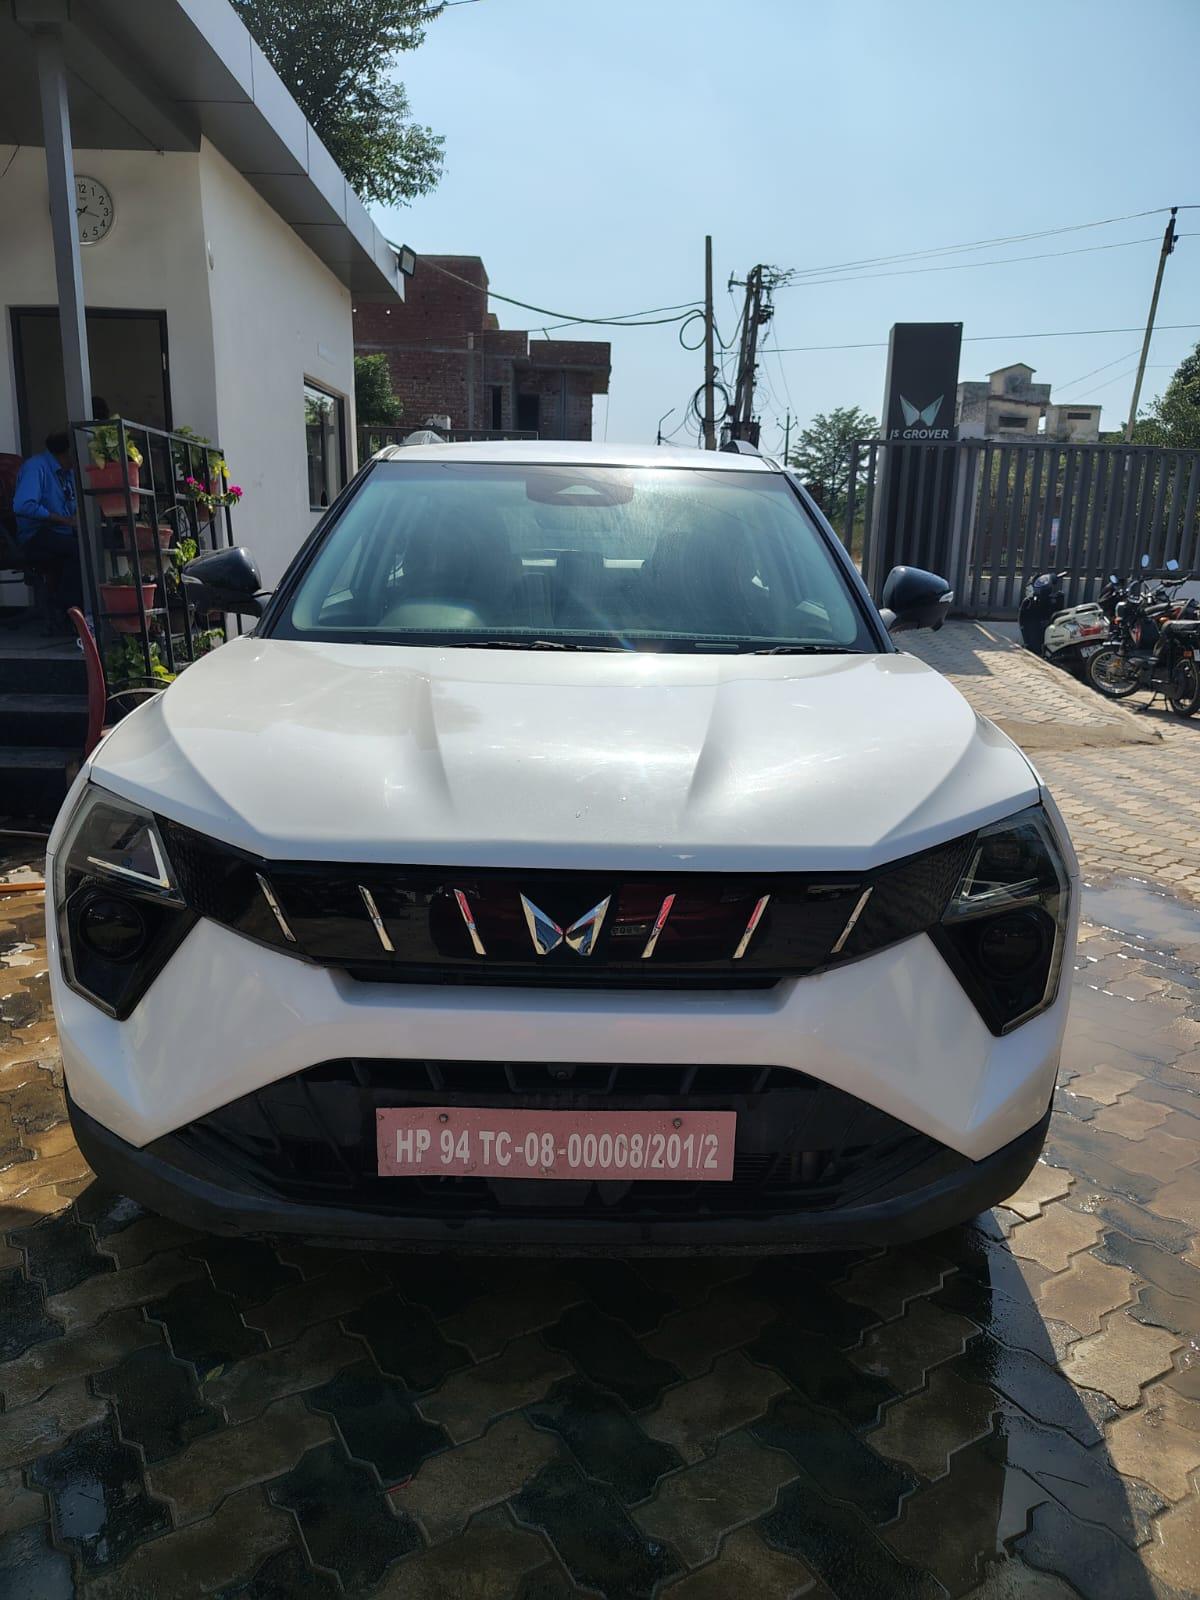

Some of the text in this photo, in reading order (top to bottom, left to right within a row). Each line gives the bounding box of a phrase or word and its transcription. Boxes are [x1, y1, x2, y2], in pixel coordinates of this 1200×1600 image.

[77, 184, 87, 193] 12
[99, 195, 105, 205] 2
[103, 207, 109, 217] 3
[100, 219, 106, 227] 4
[82, 229, 88, 238] 6
[92, 226, 98, 236] 5
[902, 429, 949, 439] GROVER
[396, 1129, 430, 1163] HP
[440, 1130, 470, 1164] 94
